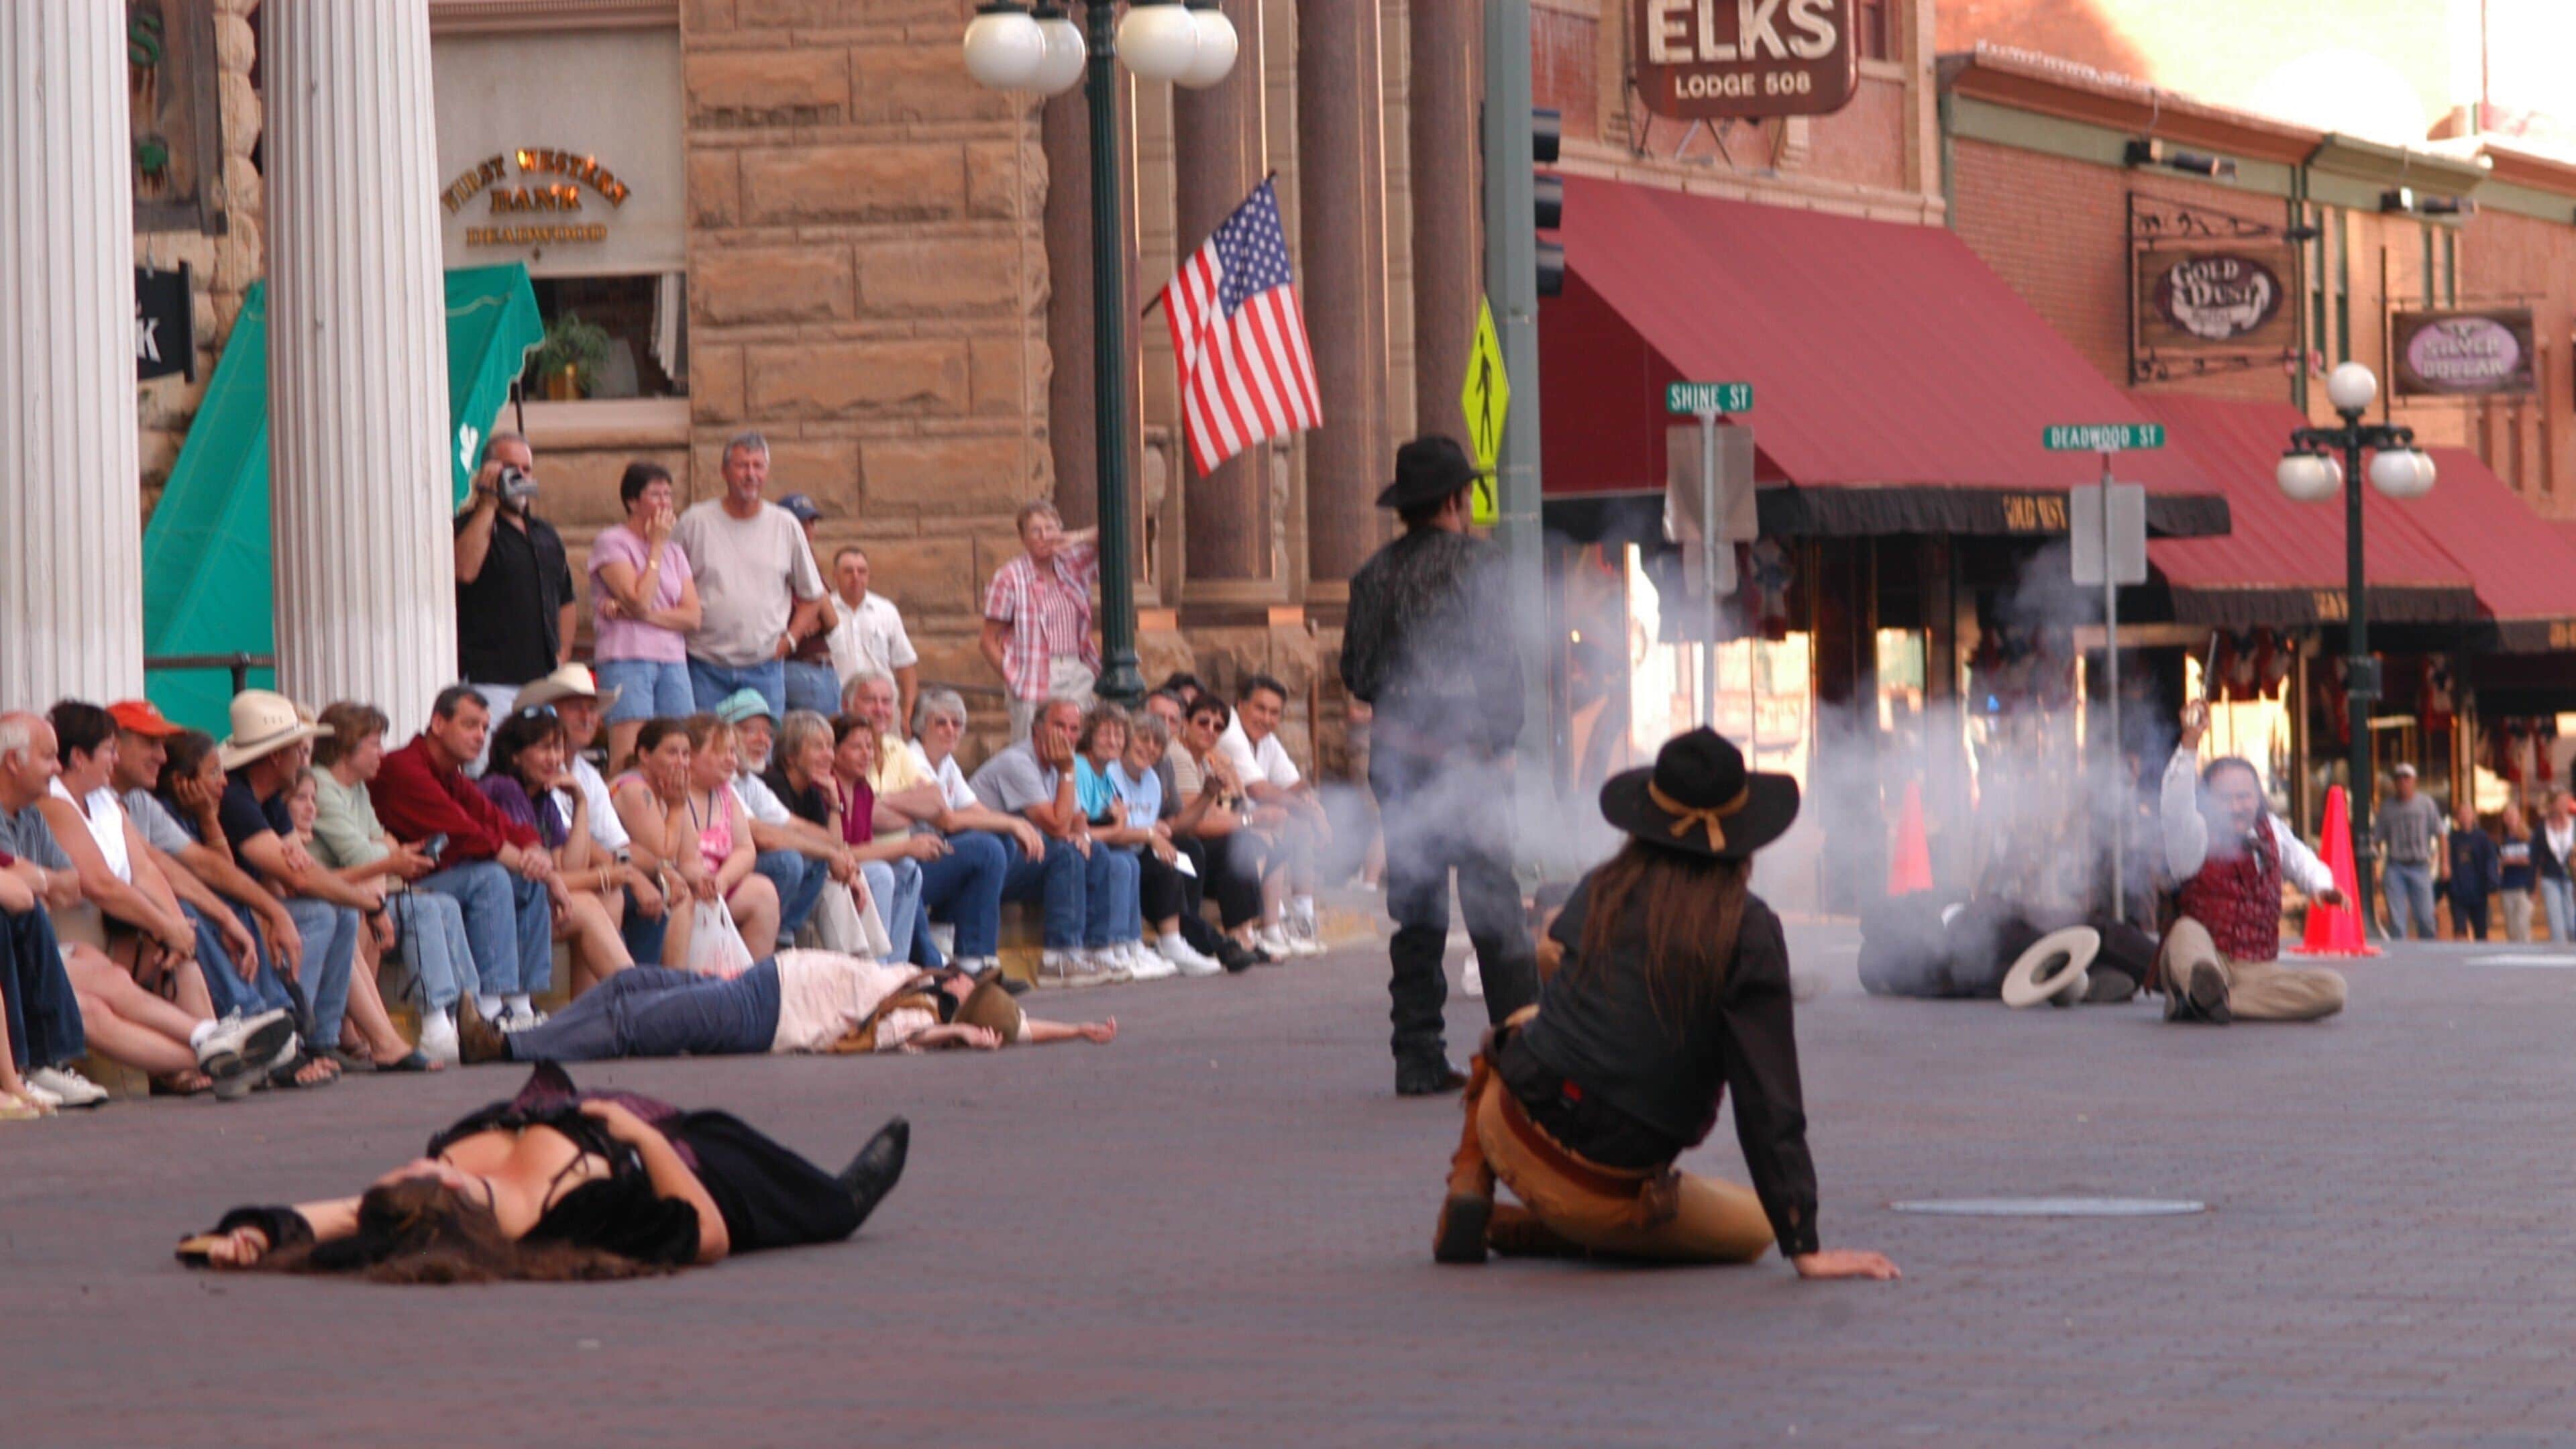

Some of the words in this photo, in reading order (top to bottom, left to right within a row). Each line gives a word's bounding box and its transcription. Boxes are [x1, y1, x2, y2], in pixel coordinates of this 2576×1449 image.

[1648, 0, 1837, 63] ELKS
[1675, 73, 1756, 99] LODGE
[1765, 71, 1811, 95] 508
[441, 154, 506, 214] FIRST
[516, 148, 631, 209] WESTERN
[490, 184, 582, 214] BANK
[466, 223, 607, 247] DEADWOOD
[2171, 260, 2239, 287] GOLD
[2190, 280, 2253, 306] DUST
[2422, 337, 2502, 358] SILVER
[2422, 360, 2504, 379] DOLLAR
[1670, 384, 1719, 411] SHINE
[1729, 384, 1748, 411] ST
[2051, 425, 2130, 449] DEADWOOD
[2139, 424, 2156, 447] ST
